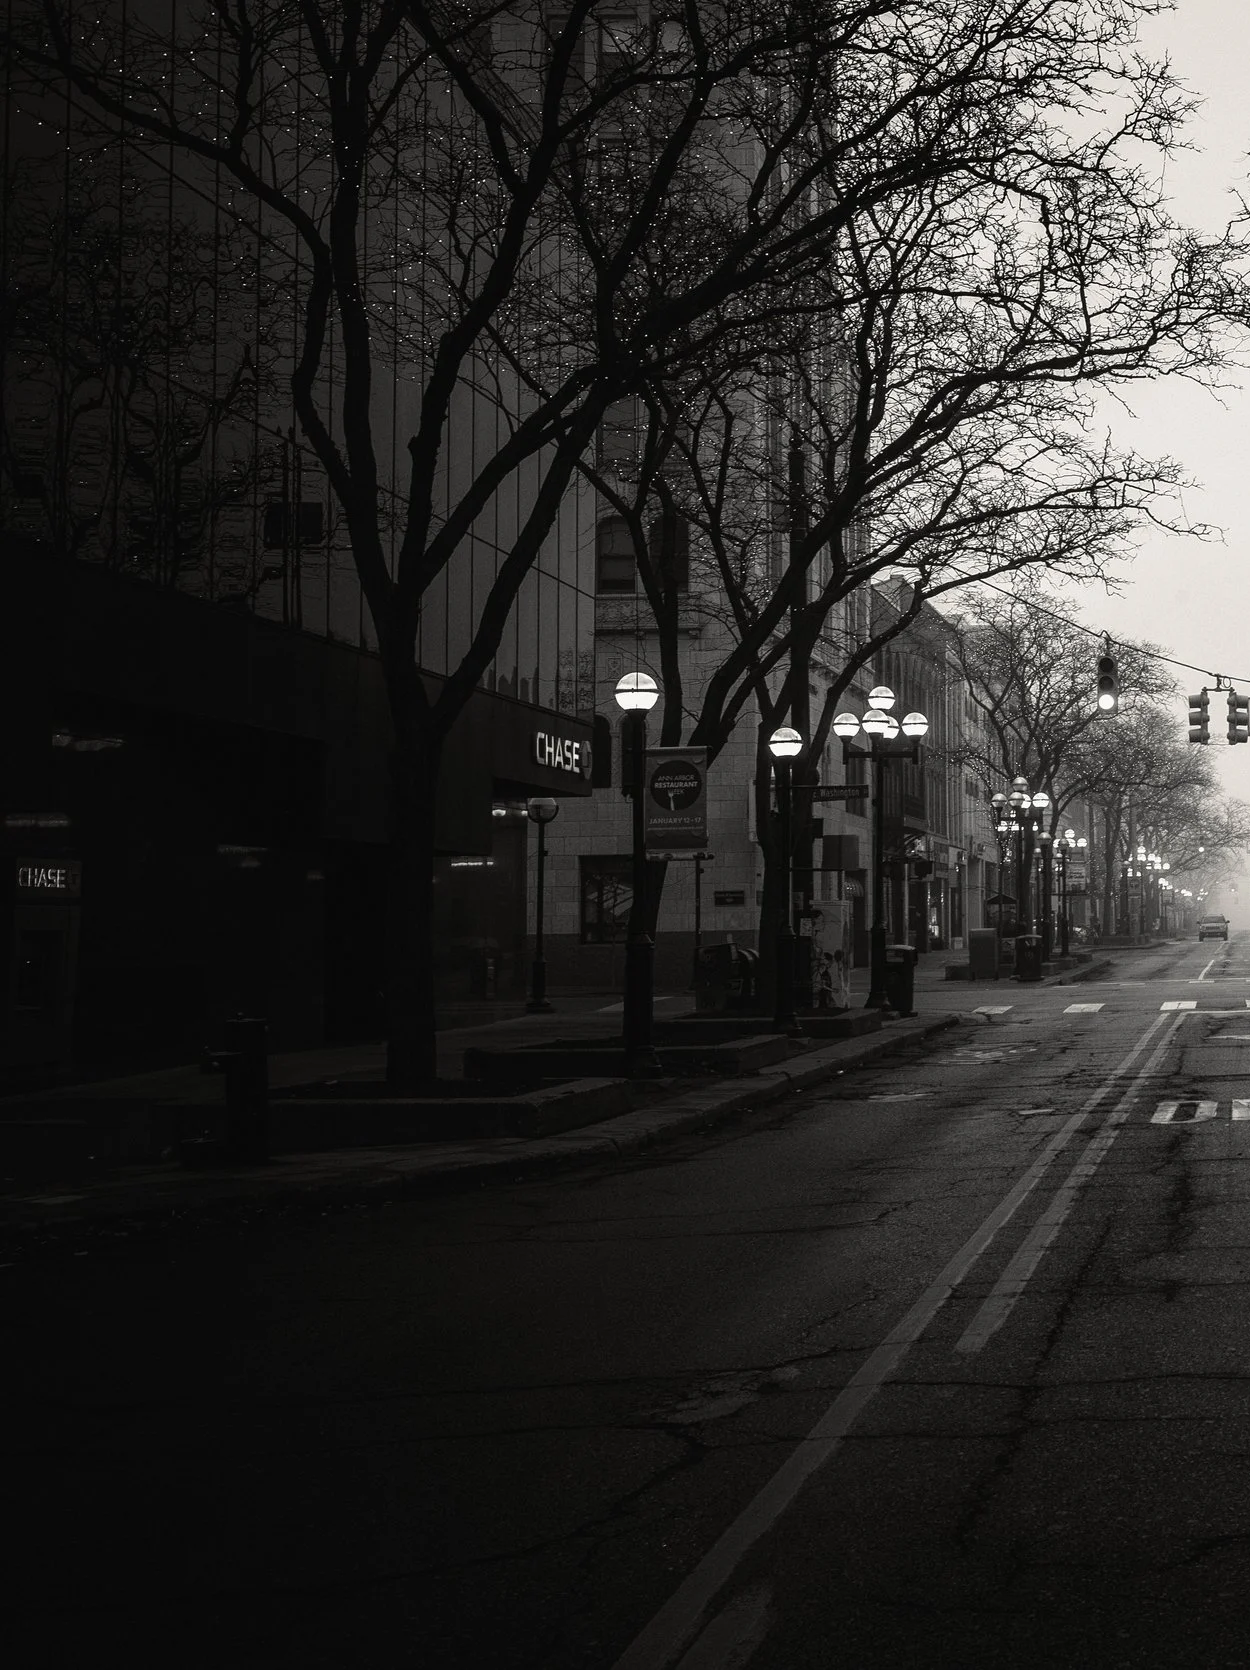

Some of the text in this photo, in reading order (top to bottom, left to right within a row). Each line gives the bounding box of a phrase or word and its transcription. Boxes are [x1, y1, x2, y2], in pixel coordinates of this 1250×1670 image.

[536, 731, 580, 774] CHASE
[654, 781, 698, 789] RESTAURANT
[649, 817, 682, 825] JANUARY
[19, 867, 66, 888] CHASE
